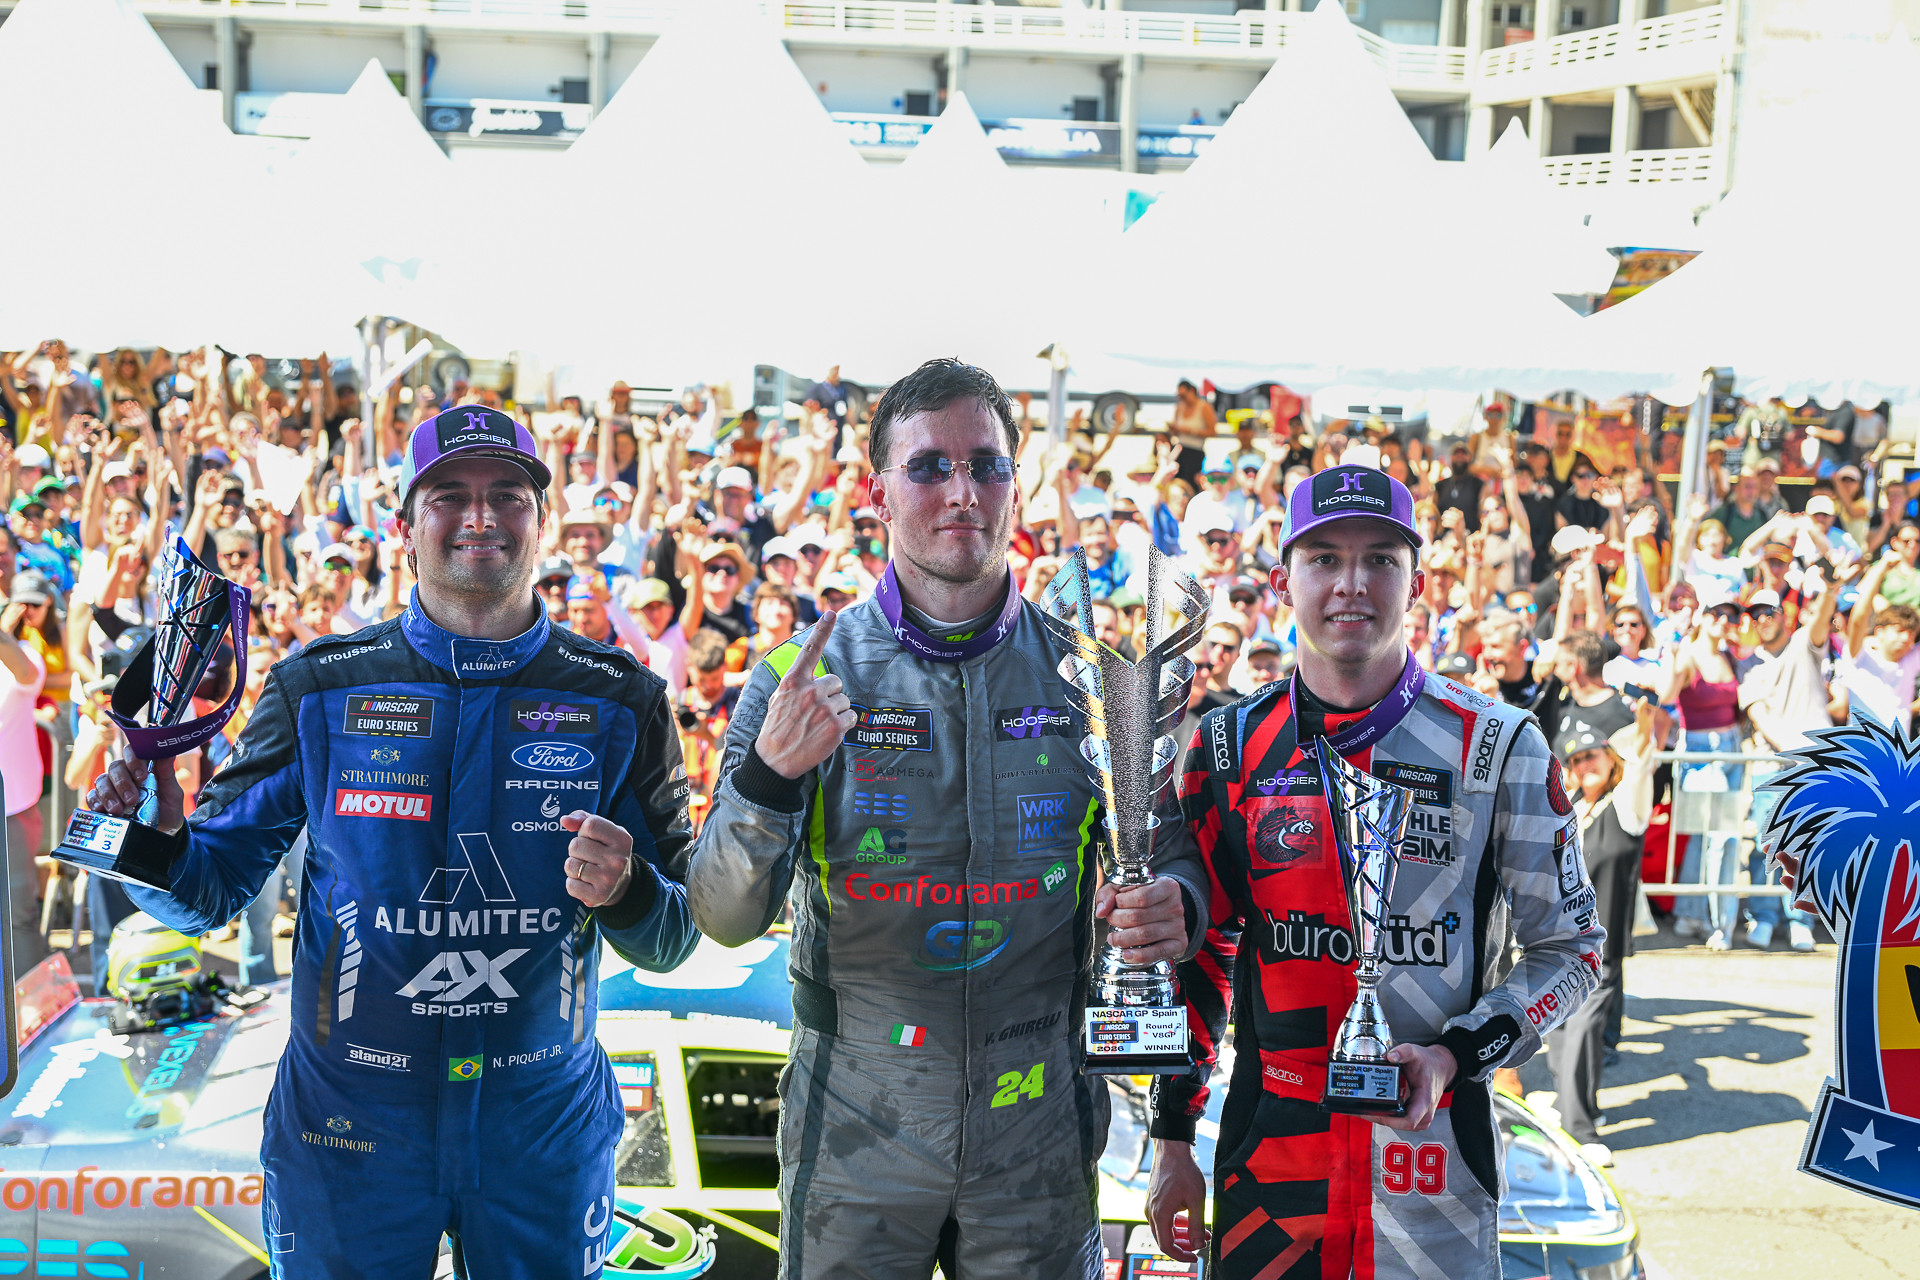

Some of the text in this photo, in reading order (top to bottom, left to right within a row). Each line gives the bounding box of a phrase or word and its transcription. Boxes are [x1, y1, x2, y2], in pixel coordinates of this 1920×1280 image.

[444, 433, 512, 447] HOOSIER
[1318, 494, 1386, 509] HOOSIER
[237, 597, 245, 660] HOOSIER
[906, 635, 964, 658] HOOSIER
[461, 660, 517, 671] ALUMITEC
[375, 701, 420, 713] NASCAR
[517, 710, 591, 723] HOOSIER
[357, 718, 419, 732] EURO SERIES
[872, 713, 917, 726] NASCAR
[1002, 714, 1071, 728] HOOSIER
[156, 717, 223, 748] HOOSIER
[857, 730, 918, 745] EURO SERIES
[1210, 714, 1231, 770] sparco
[1331, 726, 1376, 751] OSIER
[528, 745, 580, 768] Ford
[1473, 718, 1500, 781] sparco
[341, 769, 430, 787] STRATHMORE
[505, 779, 599, 790] RACING
[995, 770, 1026, 780] DRIVEN
[1256, 775, 1319, 787] HOOSIER
[1399, 768, 1437, 784] NASCAR
[1411, 788, 1439, 800] ERIES
[340, 793, 427, 817] MOTUL
[1021, 798, 1066, 818] WRK
[511, 821, 568, 832] OSMO
[1024, 819, 1063, 840] MKT
[1410, 812, 1452, 835] HLE
[101, 840, 112, 850] 3
[857, 826, 909, 854] AG
[855, 853, 907, 865] GROUP
[844, 866, 1067, 907] Conforama Più
[374, 905, 562, 938] ALUMITEC
[925, 919, 1003, 960] GP
[395, 948, 532, 1002] AX
[411, 1002, 509, 1018] SPORTS
[1092, 1009, 1178, 1018] NASCAR GP Spain
[998, 1011, 1062, 1042] GHIRELLI
[1106, 1023, 1130, 1031] NASCAR
[1477, 1033, 1510, 1057] arco
[349, 1049, 407, 1069] stand21
[492, 1044, 564, 1069] N. PIQUET JR.
[1265, 1064, 1303, 1083] sparco
[990, 1062, 1045, 1109] 24
[1376, 1087, 1387, 1097] 2
[301, 1130, 377, 1153] STRATHMORE
[1381, 1141, 1448, 1195] 99
[0, 1165, 263, 1216] onforama
